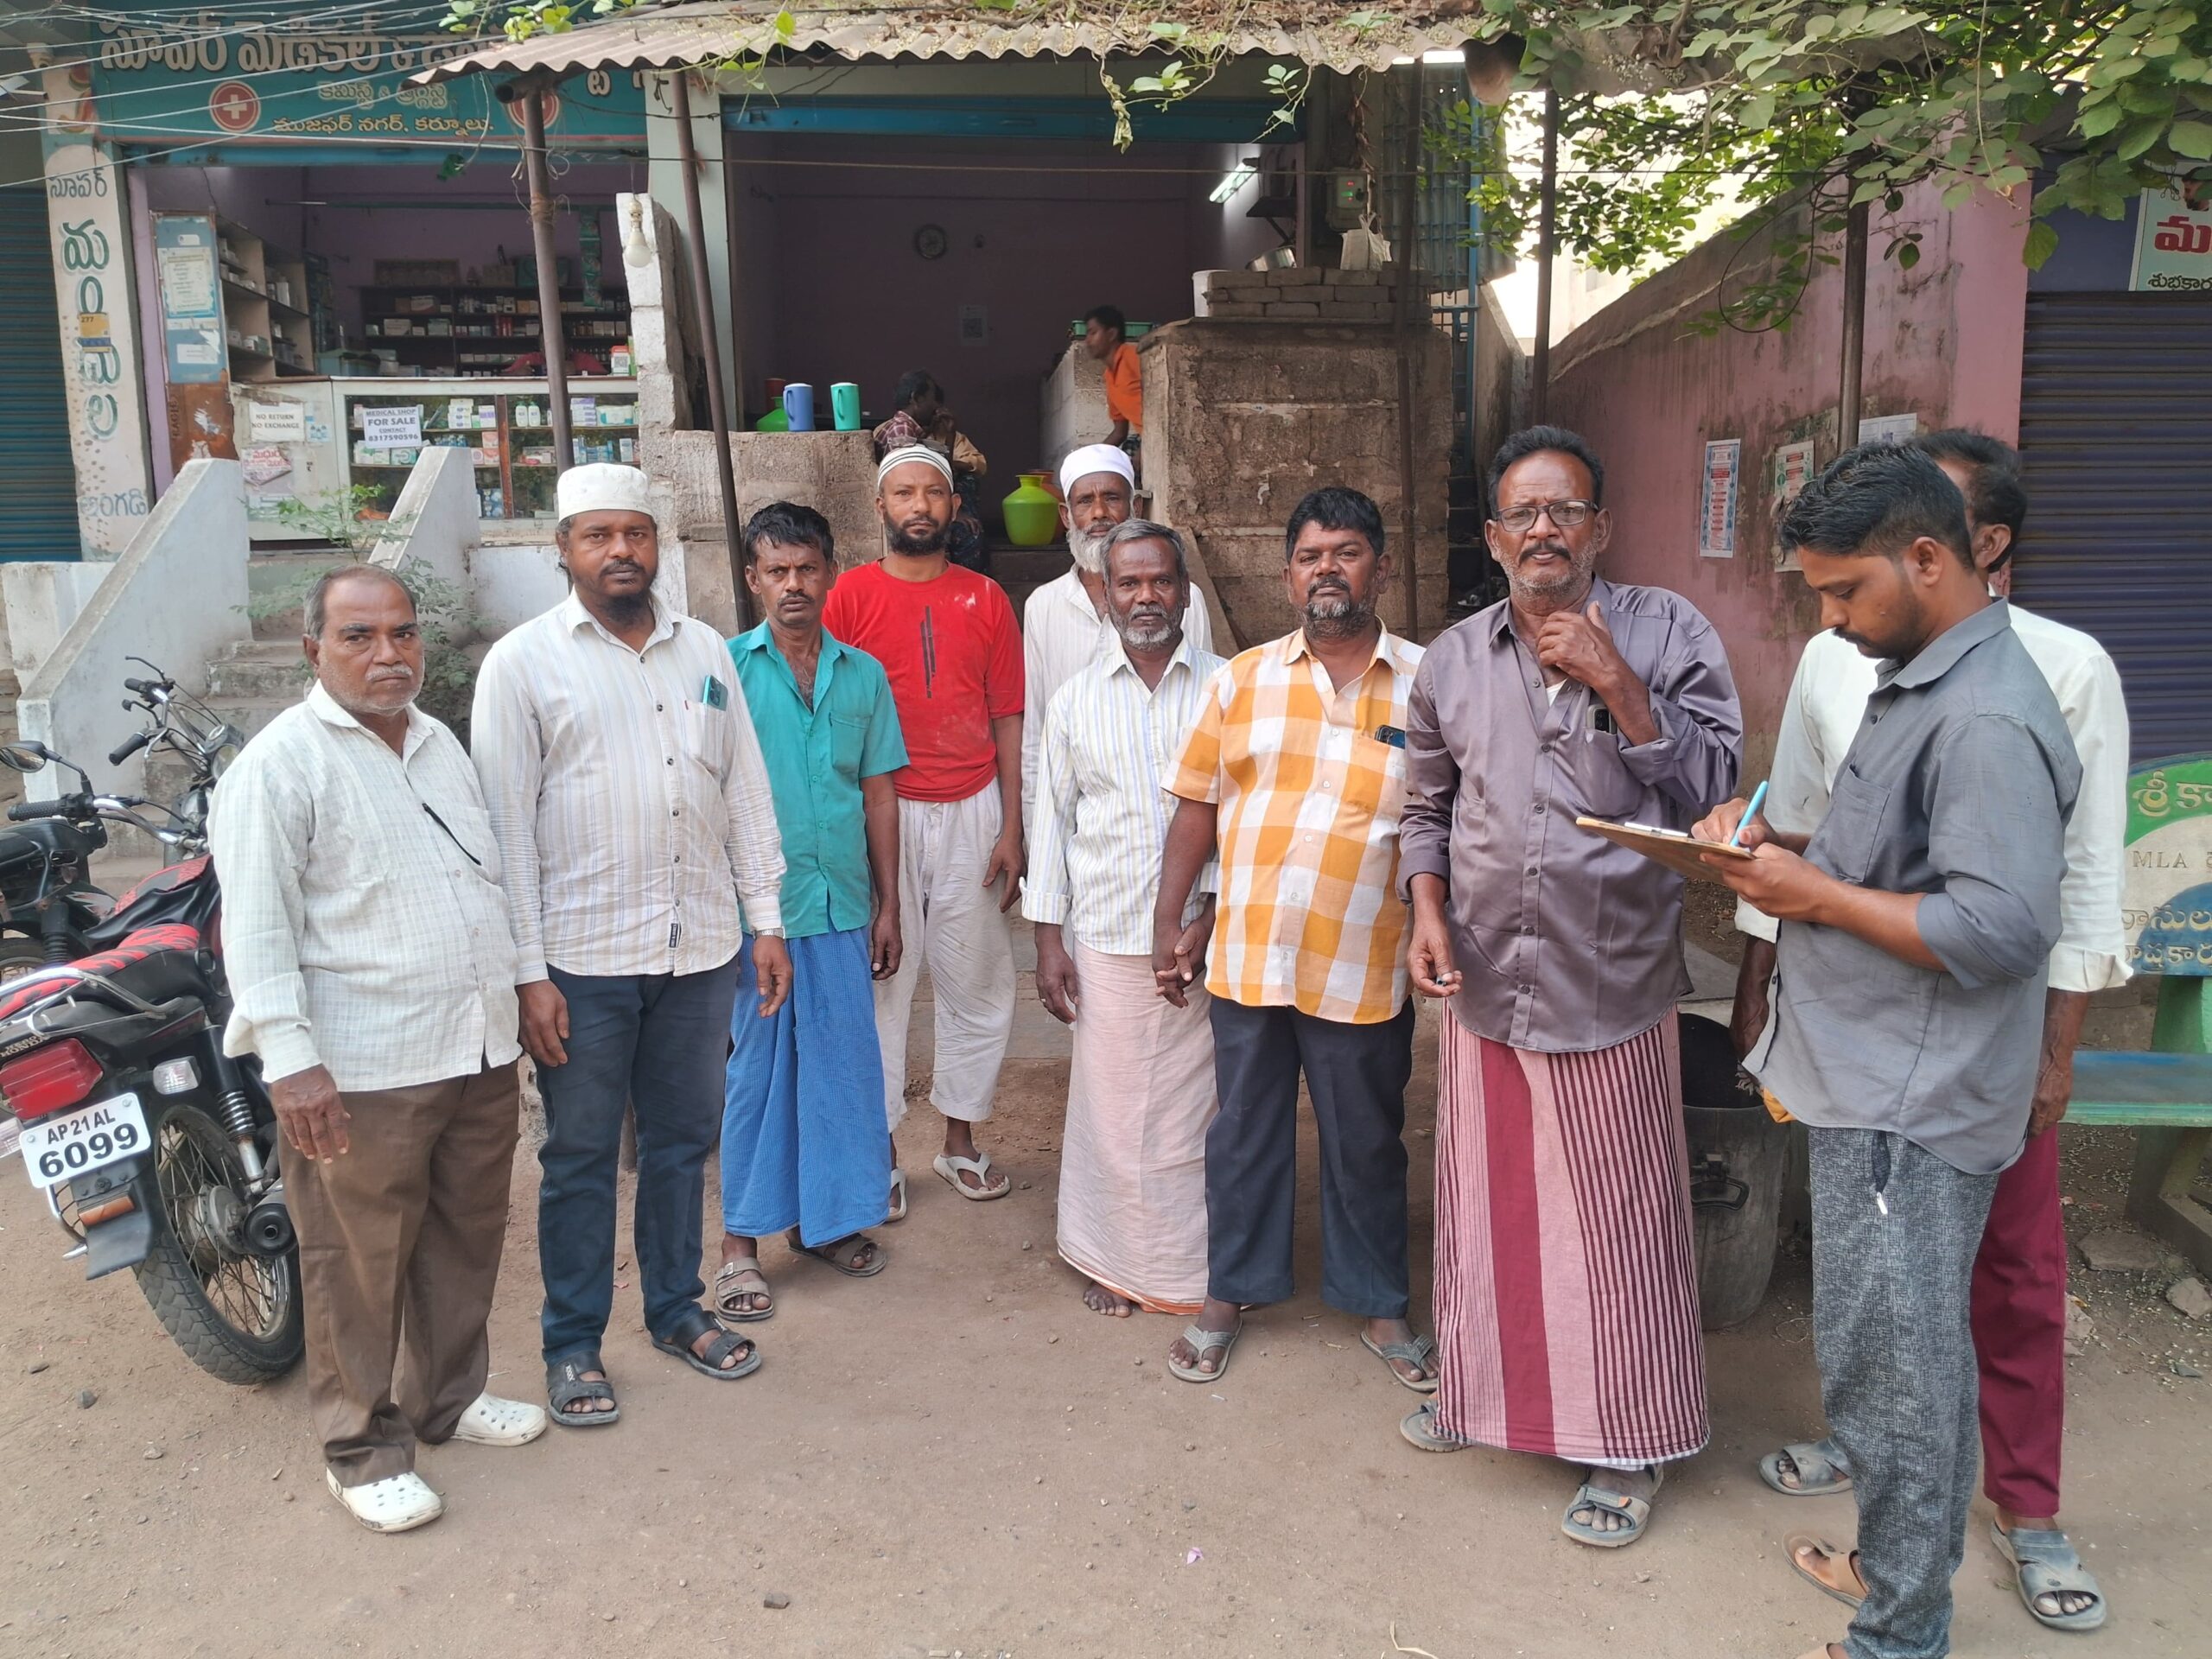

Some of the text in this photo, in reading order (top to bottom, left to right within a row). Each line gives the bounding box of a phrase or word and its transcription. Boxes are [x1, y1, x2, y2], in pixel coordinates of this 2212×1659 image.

[391, 416, 416, 425] SALE
[2133, 850, 2187, 868] MLA
[39, 1123, 139, 1178] 6099
